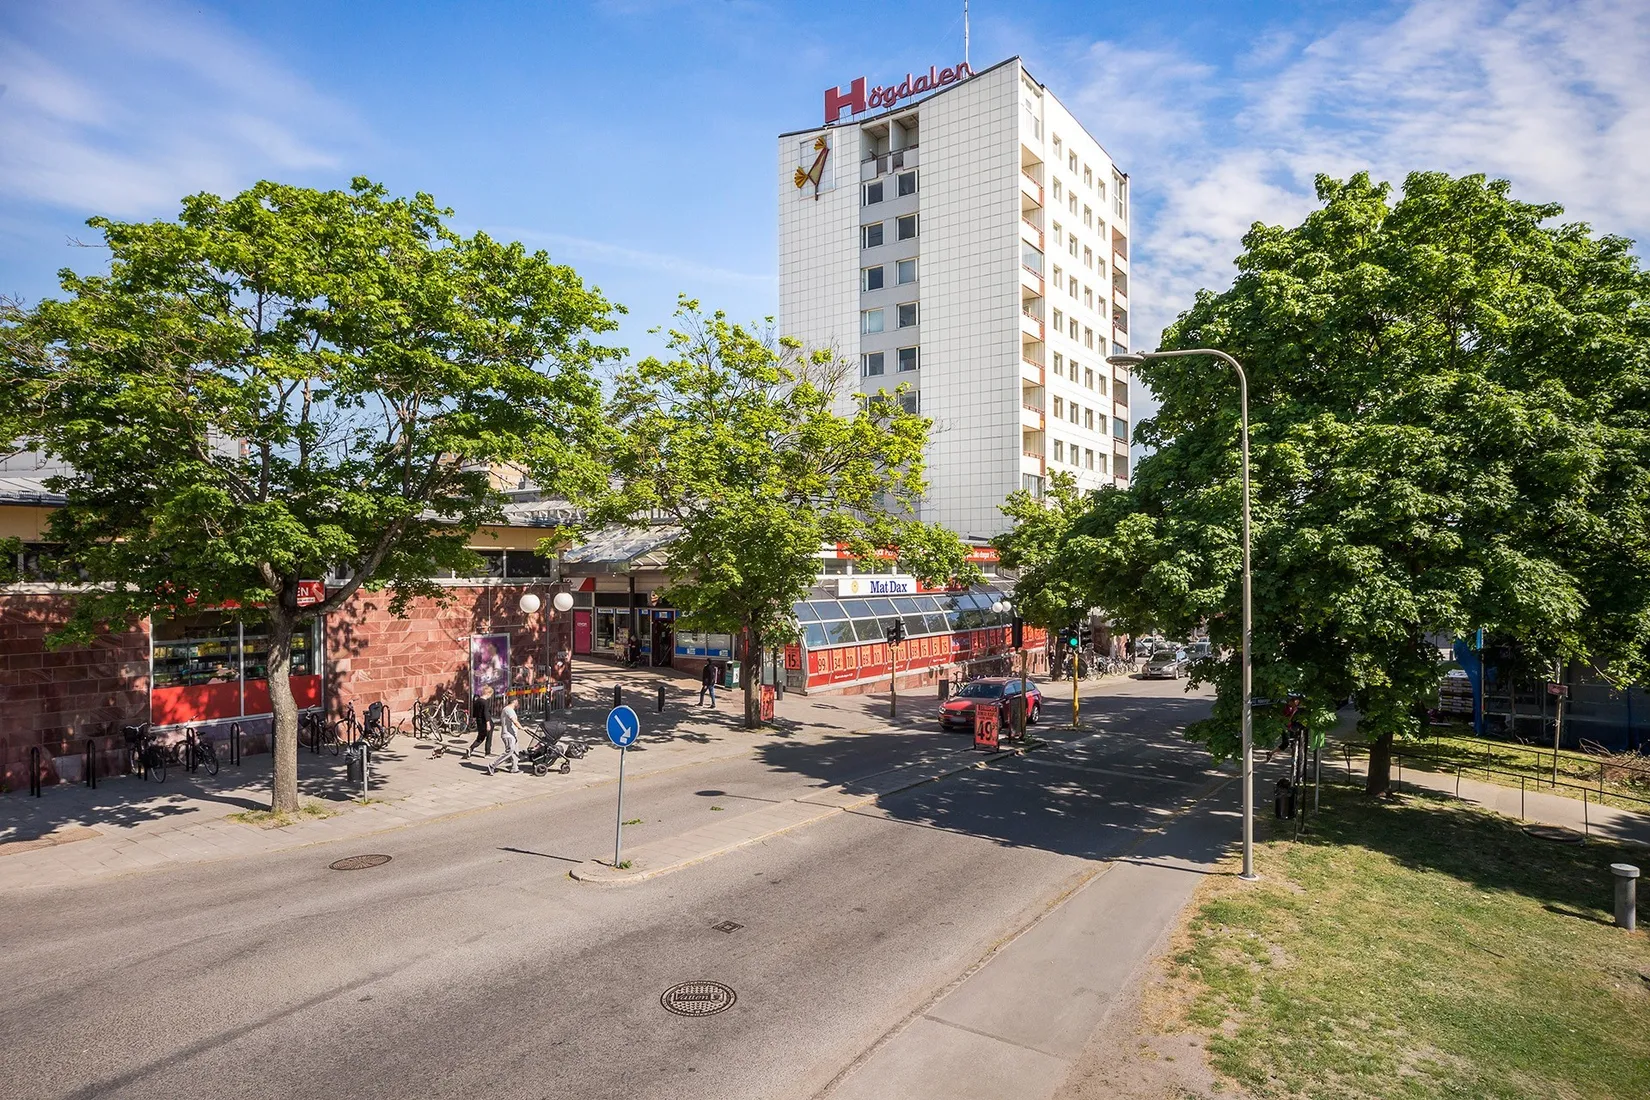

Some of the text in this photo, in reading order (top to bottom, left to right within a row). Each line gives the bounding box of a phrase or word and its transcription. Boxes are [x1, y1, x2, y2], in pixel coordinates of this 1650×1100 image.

[824, 61, 976, 123] Högdalen
[870, 580, 888, 593] Mat
[889, 580, 907, 593] Dax
[787, 653, 797, 668] 15
[977, 721, 992, 741] 49
